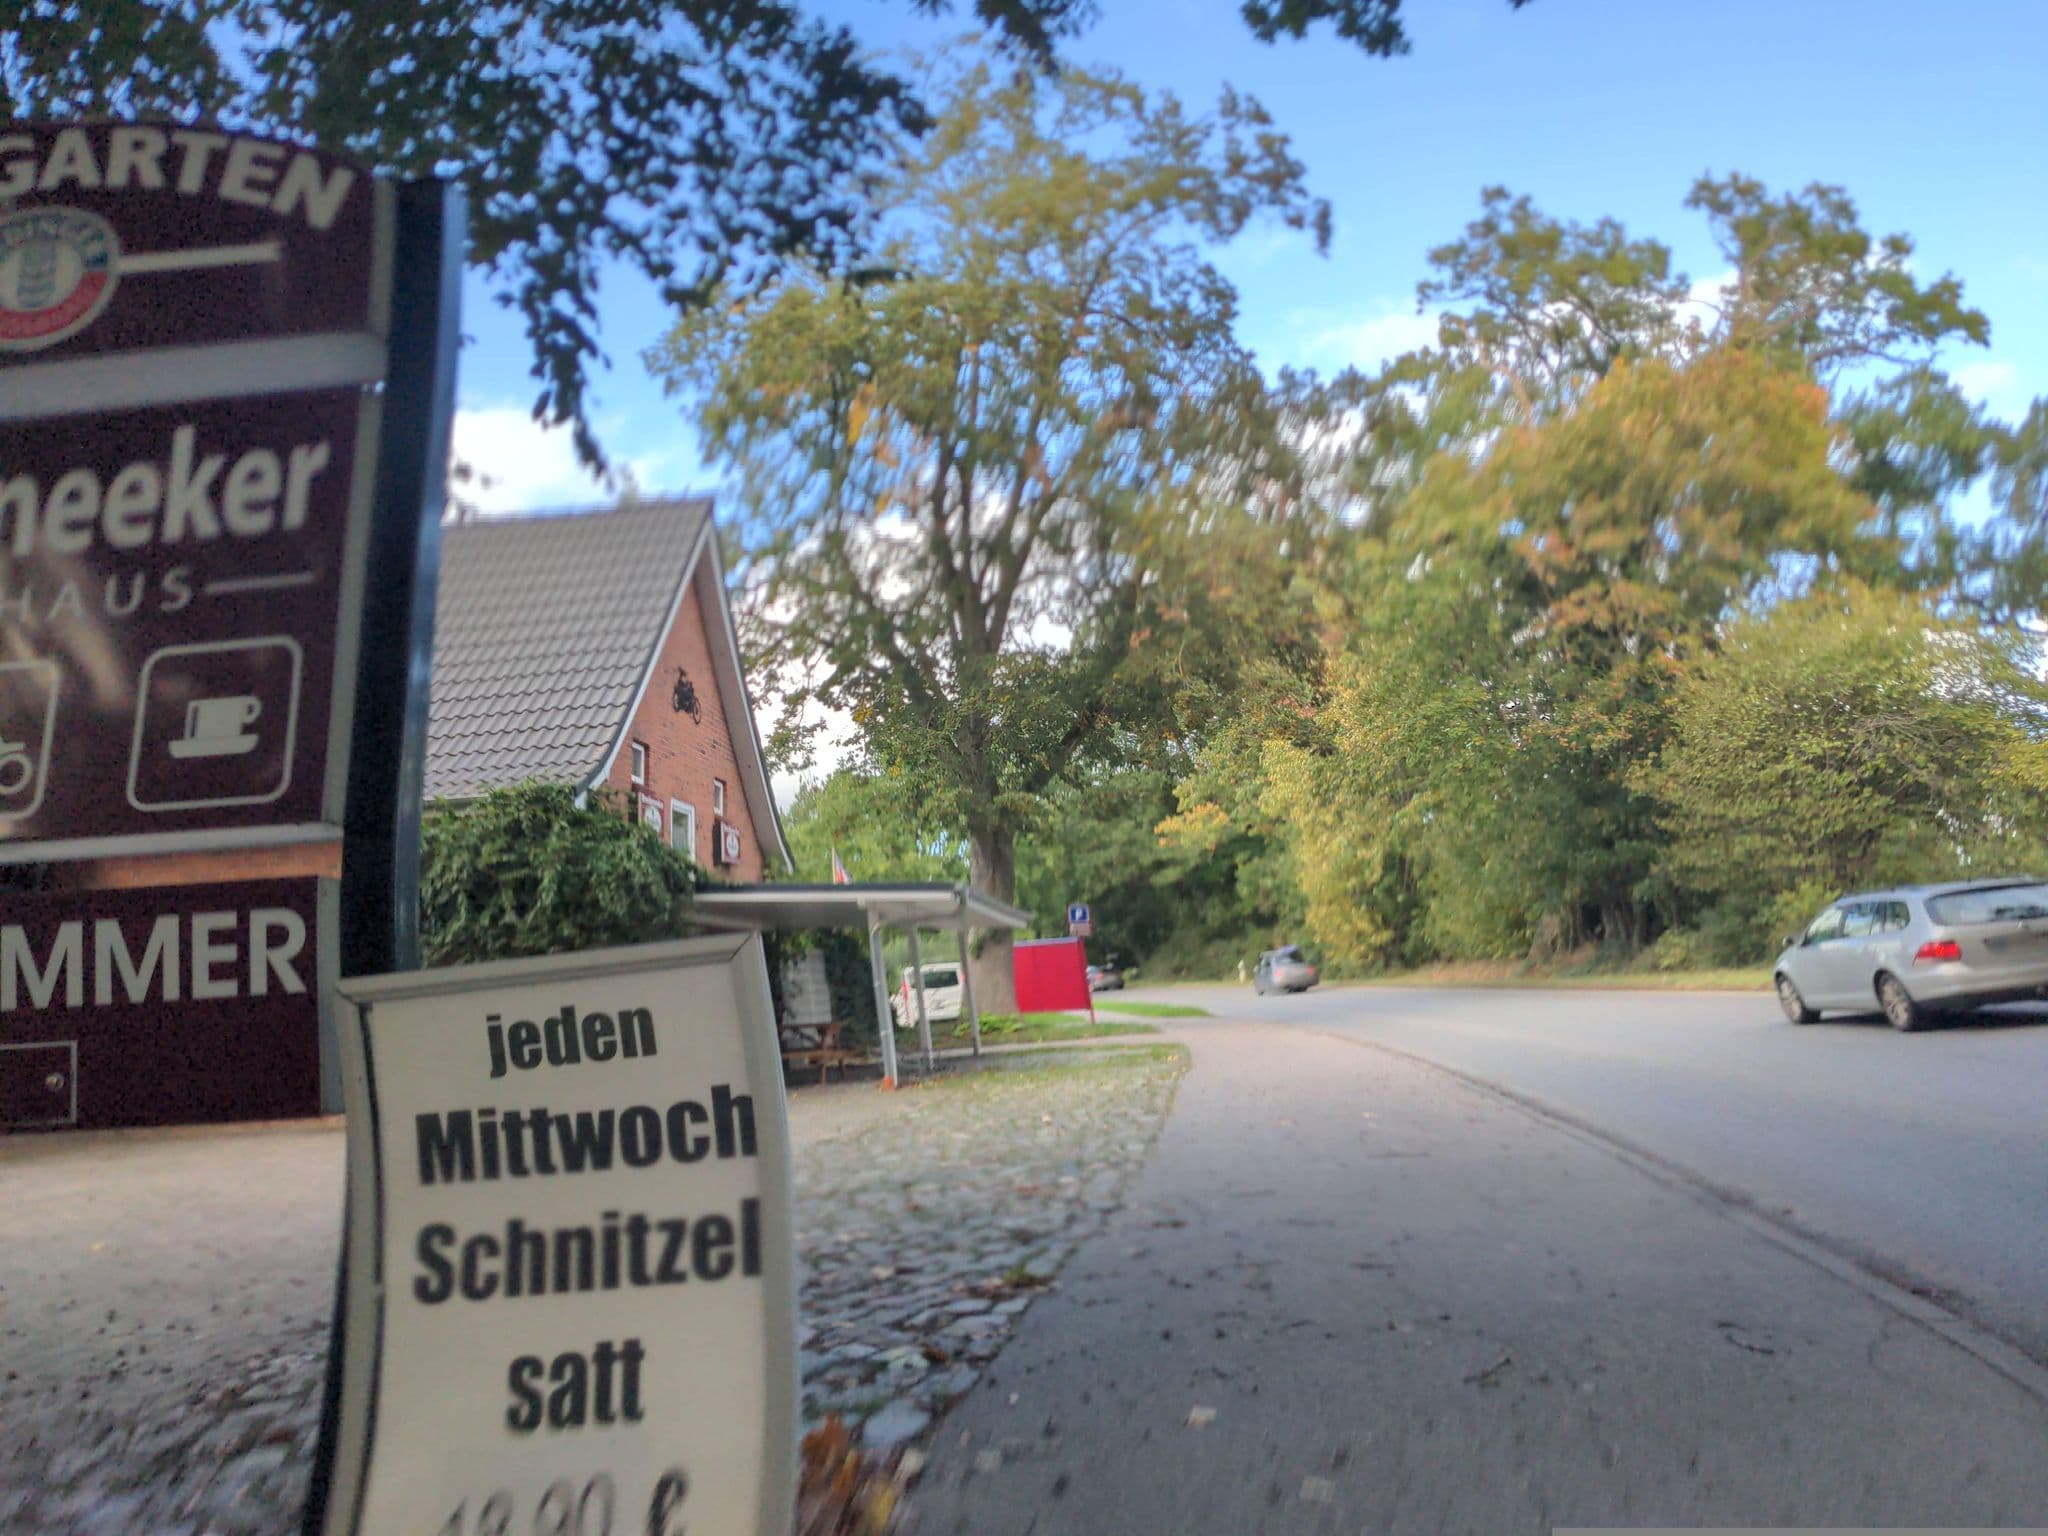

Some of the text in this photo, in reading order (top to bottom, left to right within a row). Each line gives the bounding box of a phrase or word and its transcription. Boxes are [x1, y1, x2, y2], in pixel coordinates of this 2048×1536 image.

[0, 907, 307, 1013] MMER
[486, 1004, 658, 1078] jeden
[415, 1084, 759, 1186] Mittwoch
[413, 1198, 762, 1305] Schnitzel
[505, 1338, 646, 1435] satt
